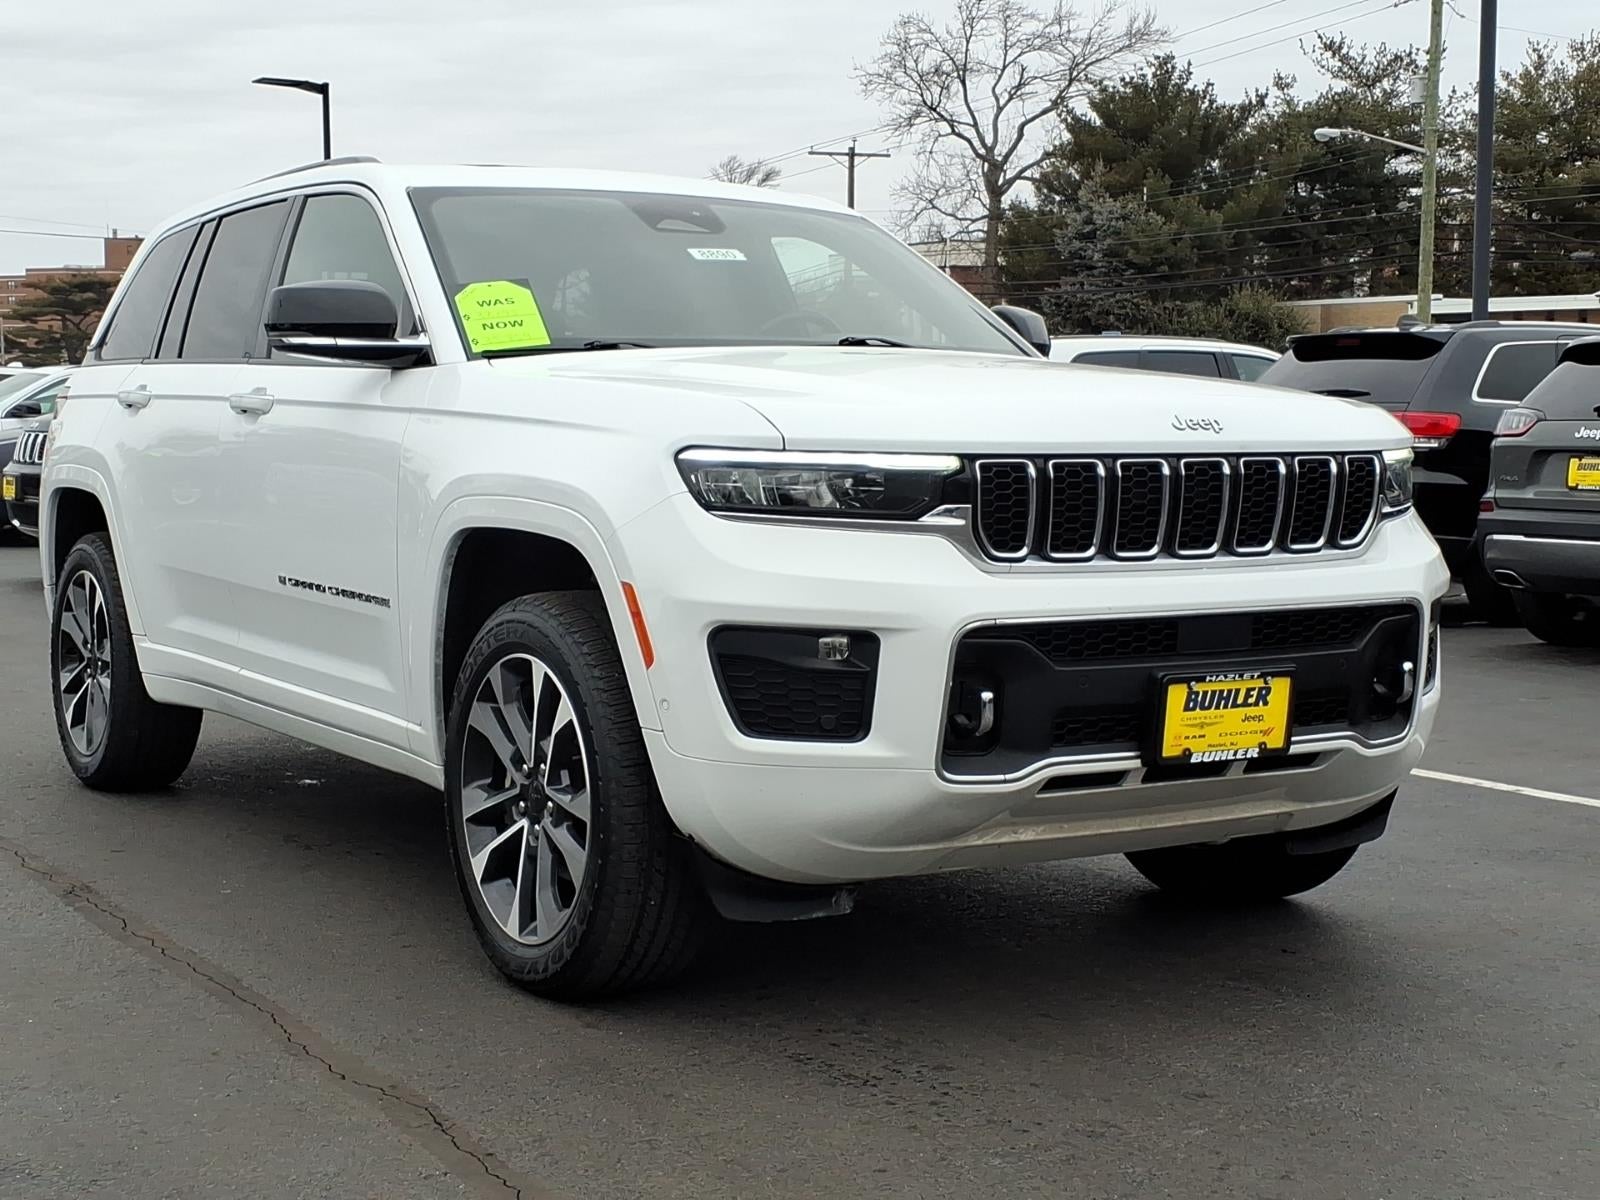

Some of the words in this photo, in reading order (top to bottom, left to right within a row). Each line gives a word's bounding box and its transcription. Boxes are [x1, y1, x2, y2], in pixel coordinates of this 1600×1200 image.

[476, 298, 515, 307] WAS
[482, 320, 523, 331] NOW
[1171, 414, 1223, 434] Jeep
[1206, 672, 1261, 682] HAZLET
[1183, 686, 1272, 712] BUHLER
[1241, 712, 1265, 724] Jeep
[1190, 748, 1259, 763] BUHLER
